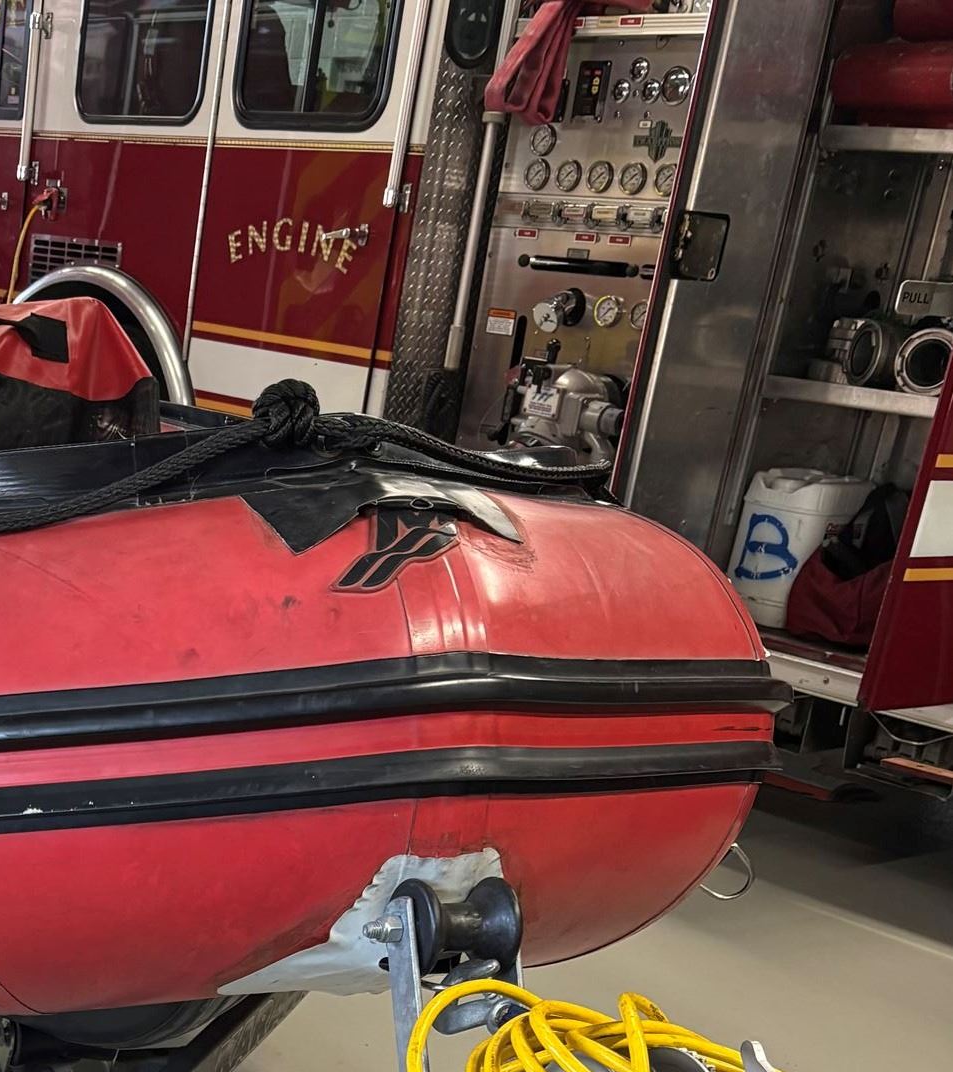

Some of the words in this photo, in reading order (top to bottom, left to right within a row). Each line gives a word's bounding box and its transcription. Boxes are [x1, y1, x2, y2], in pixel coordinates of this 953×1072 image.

[227, 217, 358, 275] ENGINE
[902, 291, 929, 305] PULL
[734, 513, 799, 580] B
